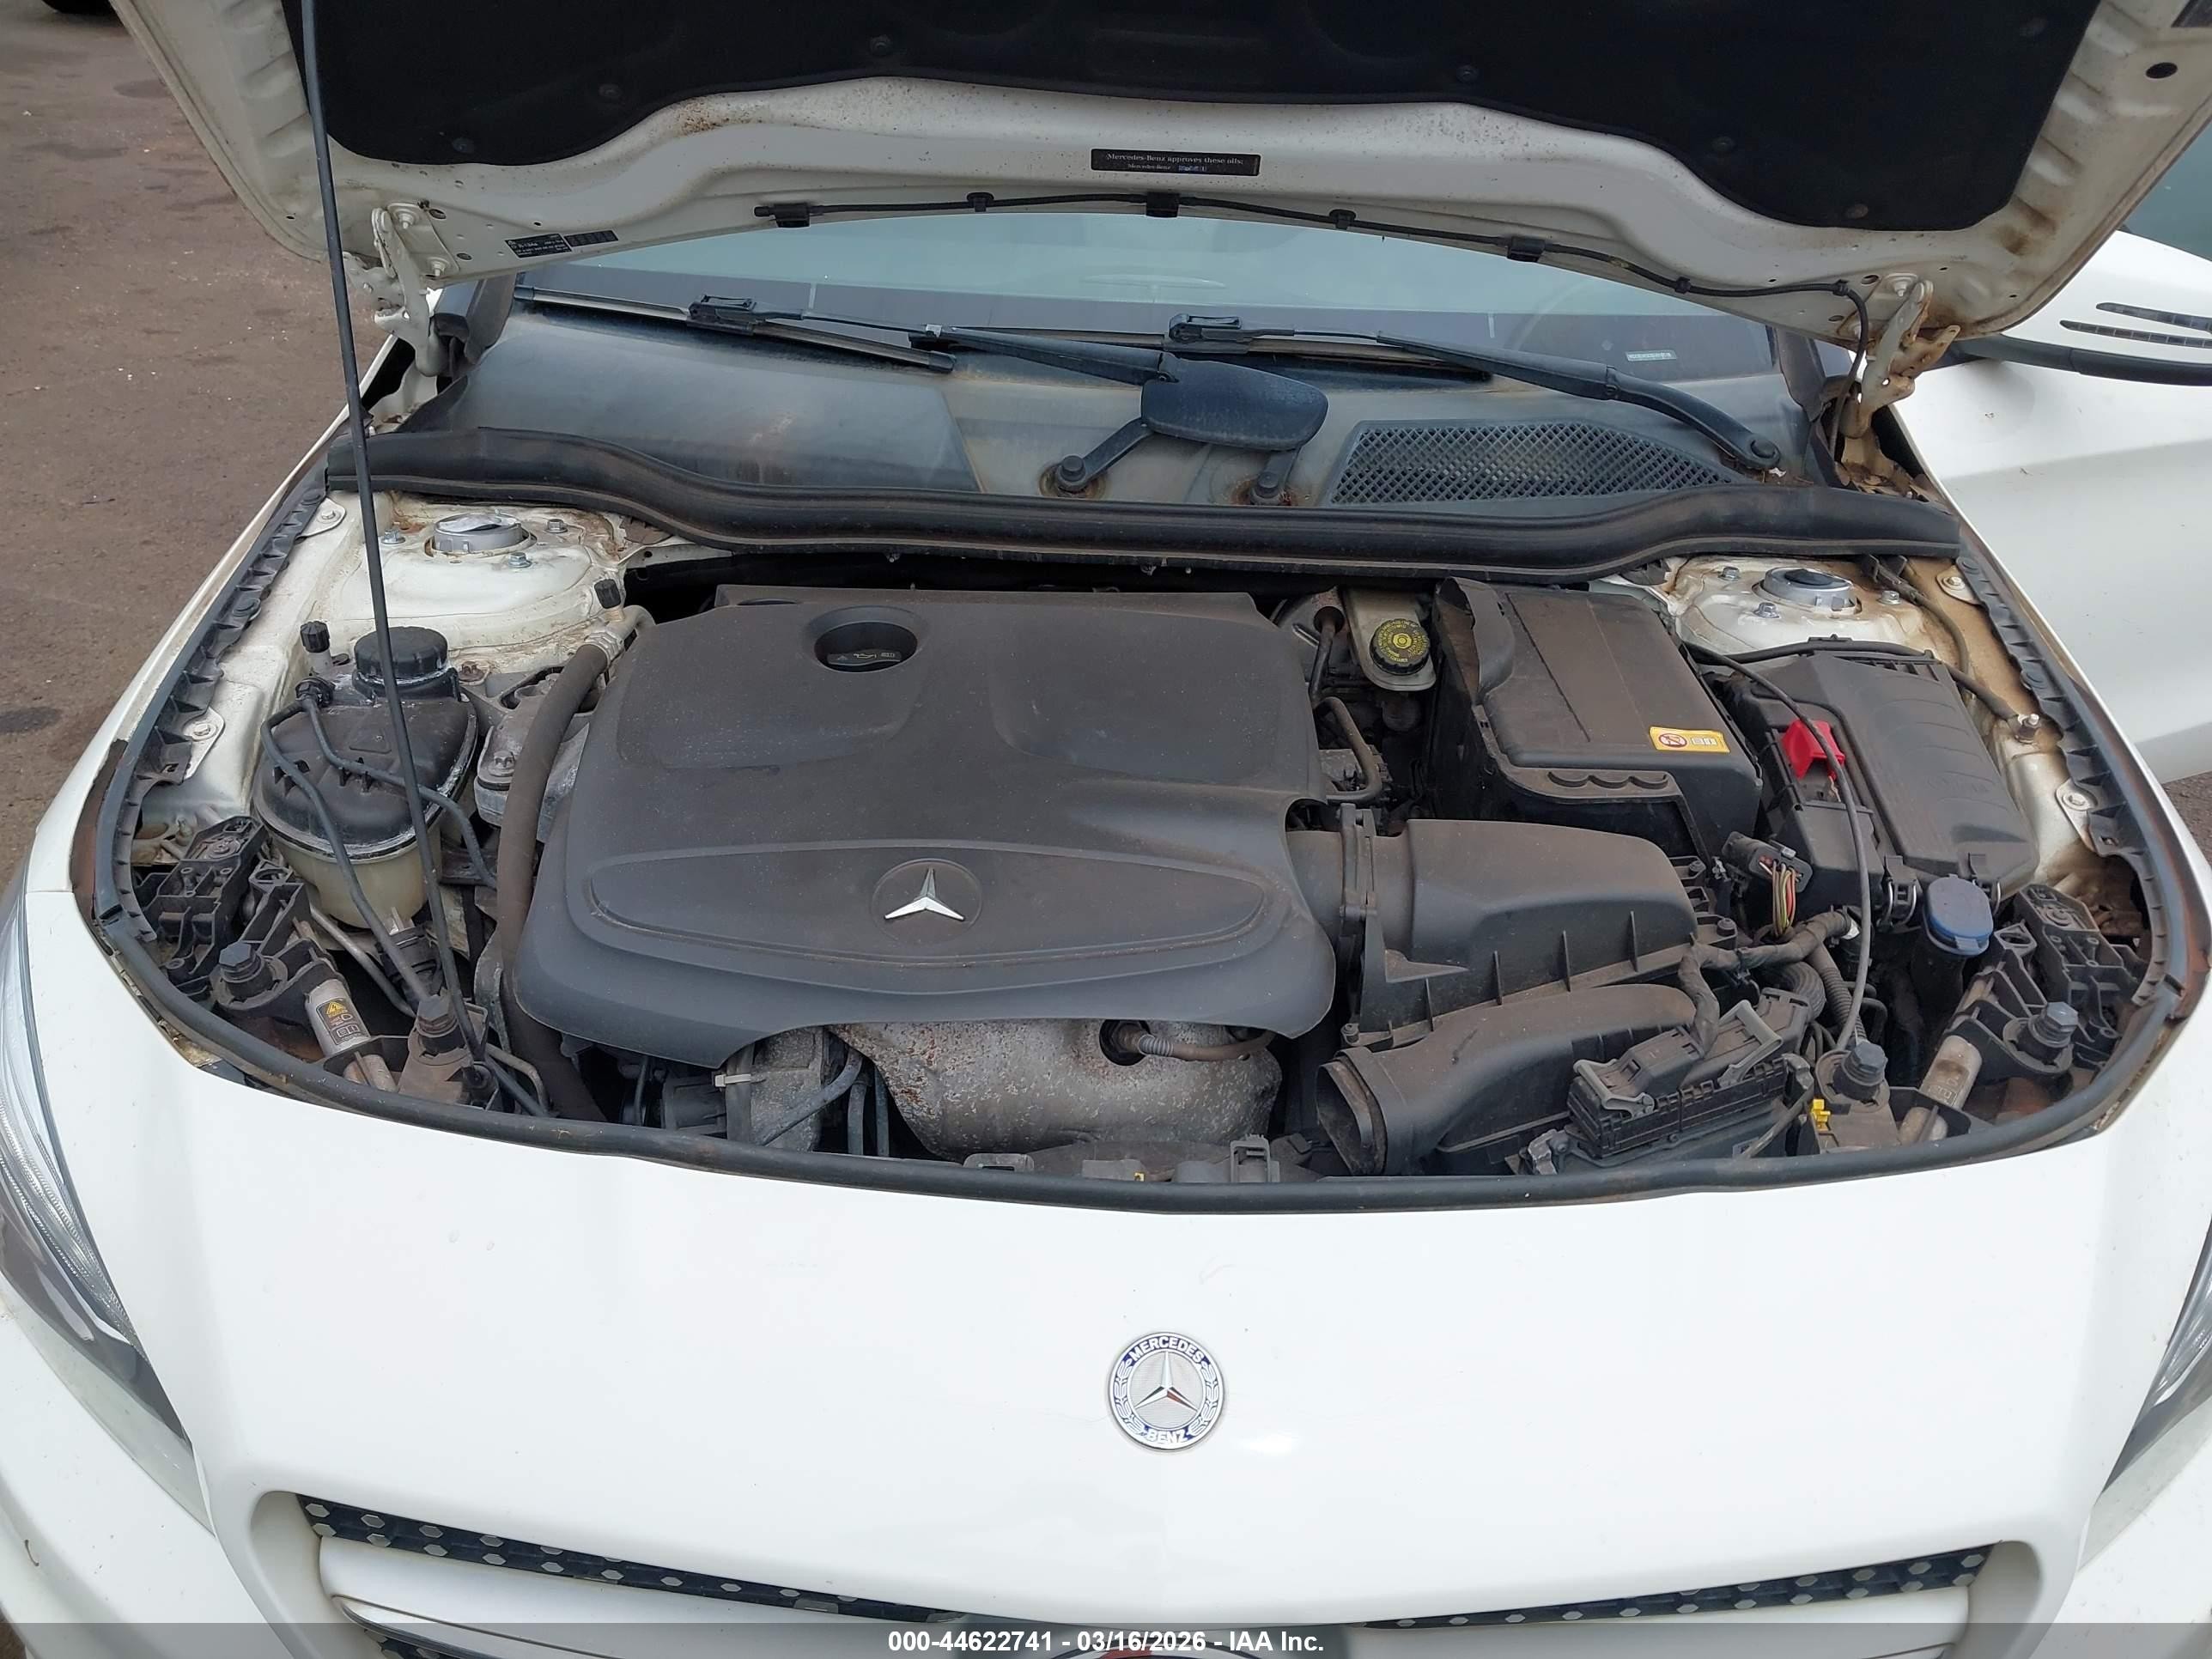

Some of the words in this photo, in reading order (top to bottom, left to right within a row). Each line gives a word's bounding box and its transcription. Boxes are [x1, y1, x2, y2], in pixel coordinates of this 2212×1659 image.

[1106, 153, 1165, 161] Mercedes-Benz
[1166, 155, 1202, 164] approves
[1128, 1336, 1206, 1363] MERCEDES
[1146, 1429, 1188, 1444] BENZ
